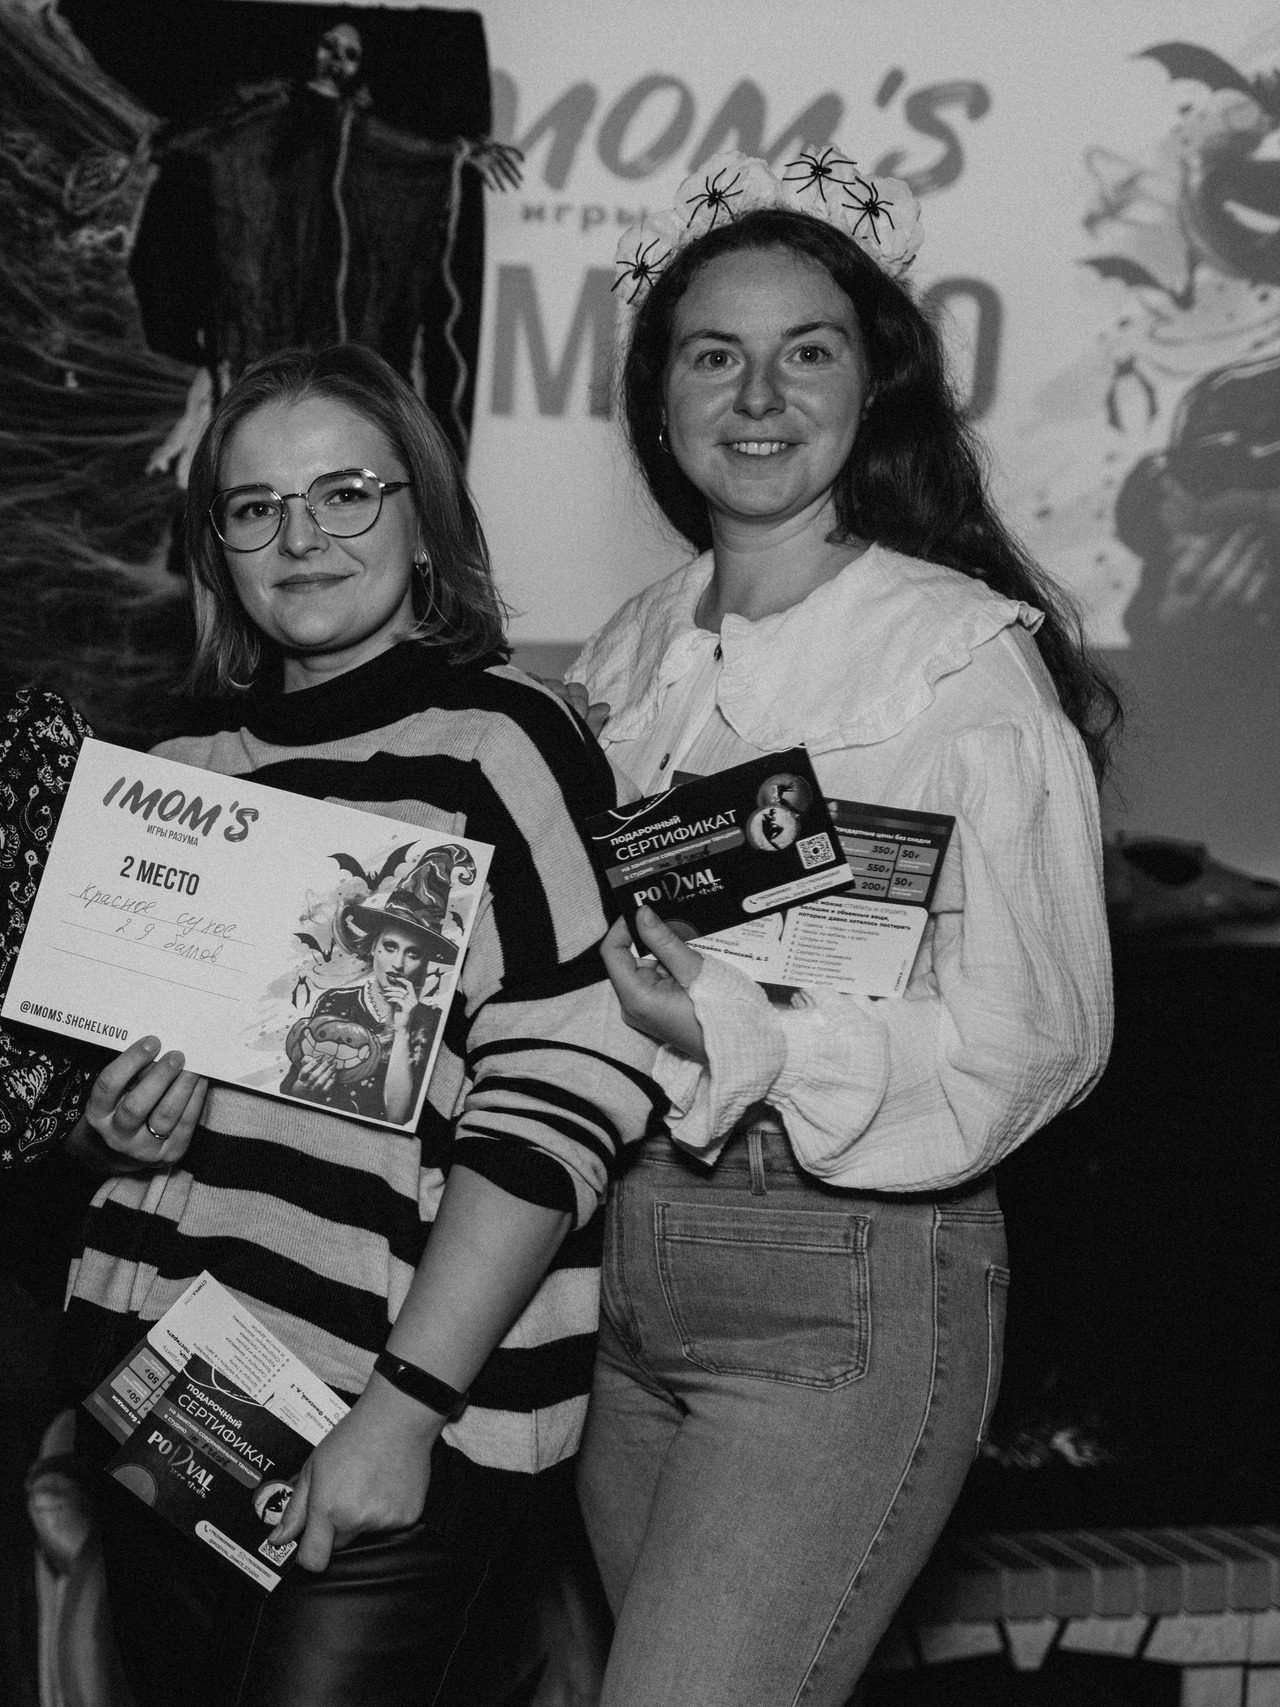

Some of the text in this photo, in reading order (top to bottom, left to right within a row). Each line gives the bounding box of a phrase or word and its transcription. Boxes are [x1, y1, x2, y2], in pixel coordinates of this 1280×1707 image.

[102, 777, 259, 843] IMOM'S
[610, 814, 681, 845] ПОДАРОЧНЫЙ
[147, 824, 199, 847] ИГРЫ РАЗУМА
[616, 809, 738, 860] СЕРТИФИКАТ
[630, 856, 659, 869] занятиях
[710, 829, 740, 842] танцами
[834, 826, 875, 836] тандартные
[120, 855, 200, 896] 2 МЕСТО
[79, 882, 157, 913] Красное
[20, 1000, 128, 1041] @IMOMS.SHCHELKOVO
[166, 1417, 187, 1434] студию
[186, 1383, 243, 1429] ПОДАРОЧНЫЙ
[168, 1407, 261, 1481] на занятиях современными танцами
[176, 1393, 275, 1473] СЕРТИФИКАТ
[146, 1429, 214, 1492] PODVAL
